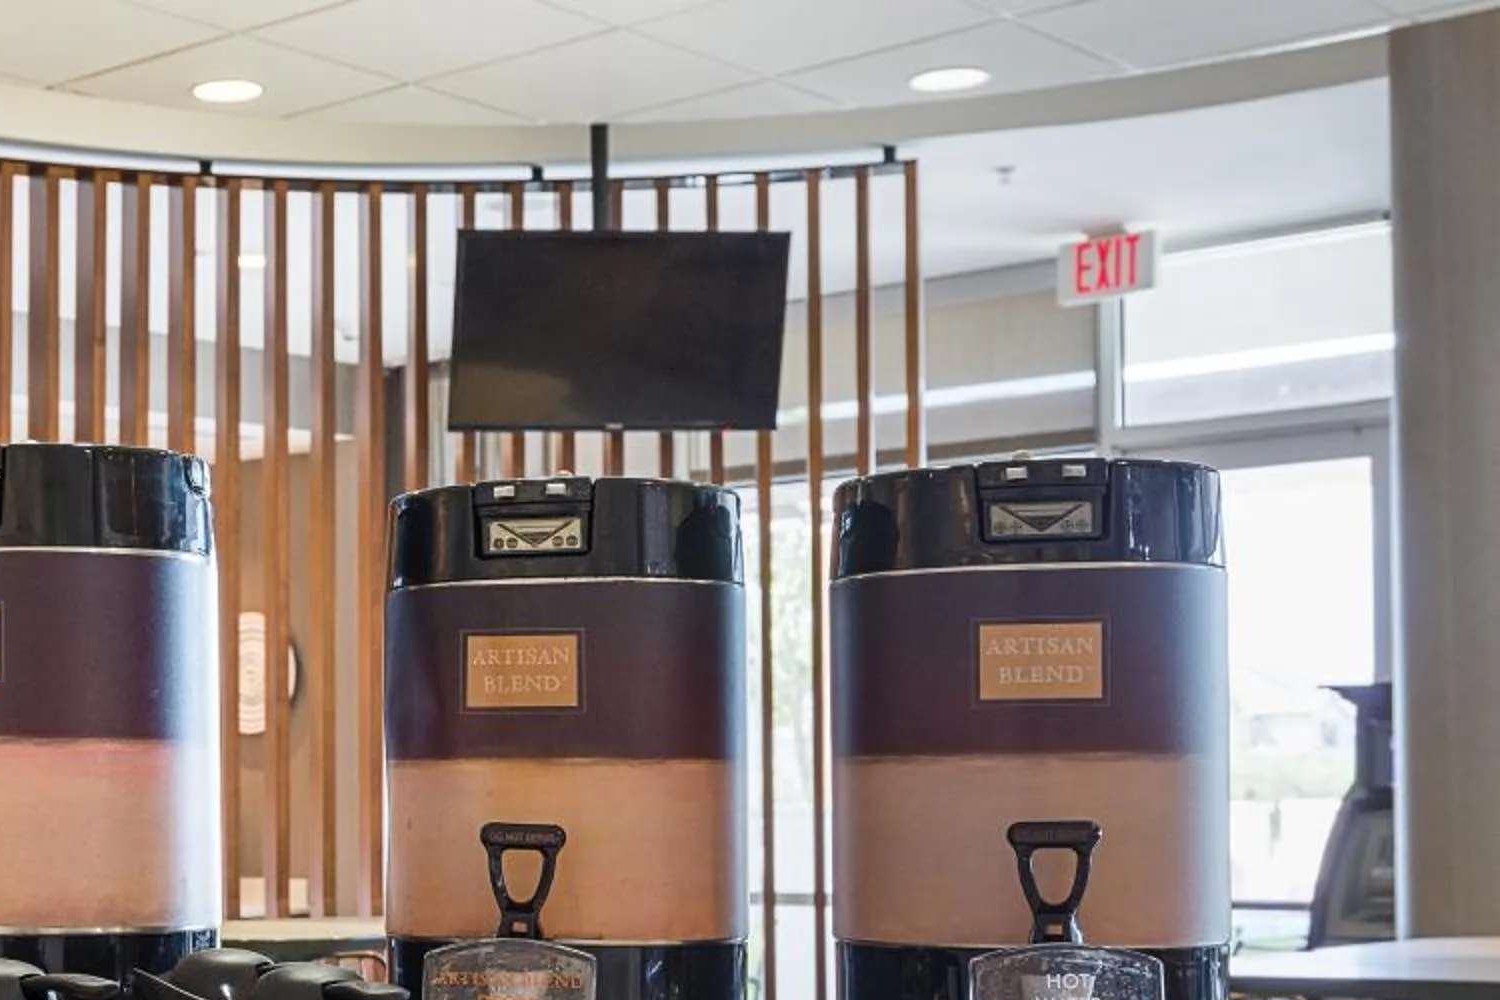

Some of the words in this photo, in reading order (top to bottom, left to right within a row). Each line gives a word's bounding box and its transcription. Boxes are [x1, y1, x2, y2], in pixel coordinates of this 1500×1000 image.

[1075, 234, 1139, 295] EXIT
[473, 646, 569, 665] ARTISAN
[985, 637, 1094, 656] ARTISAN
[484, 674, 561, 693] BLEND
[998, 665, 1084, 685] BLEND
[433, 970, 514, 988] ARTISAN
[521, 971, 584, 989] BLEND
[1046, 973, 1092, 990] HOT
